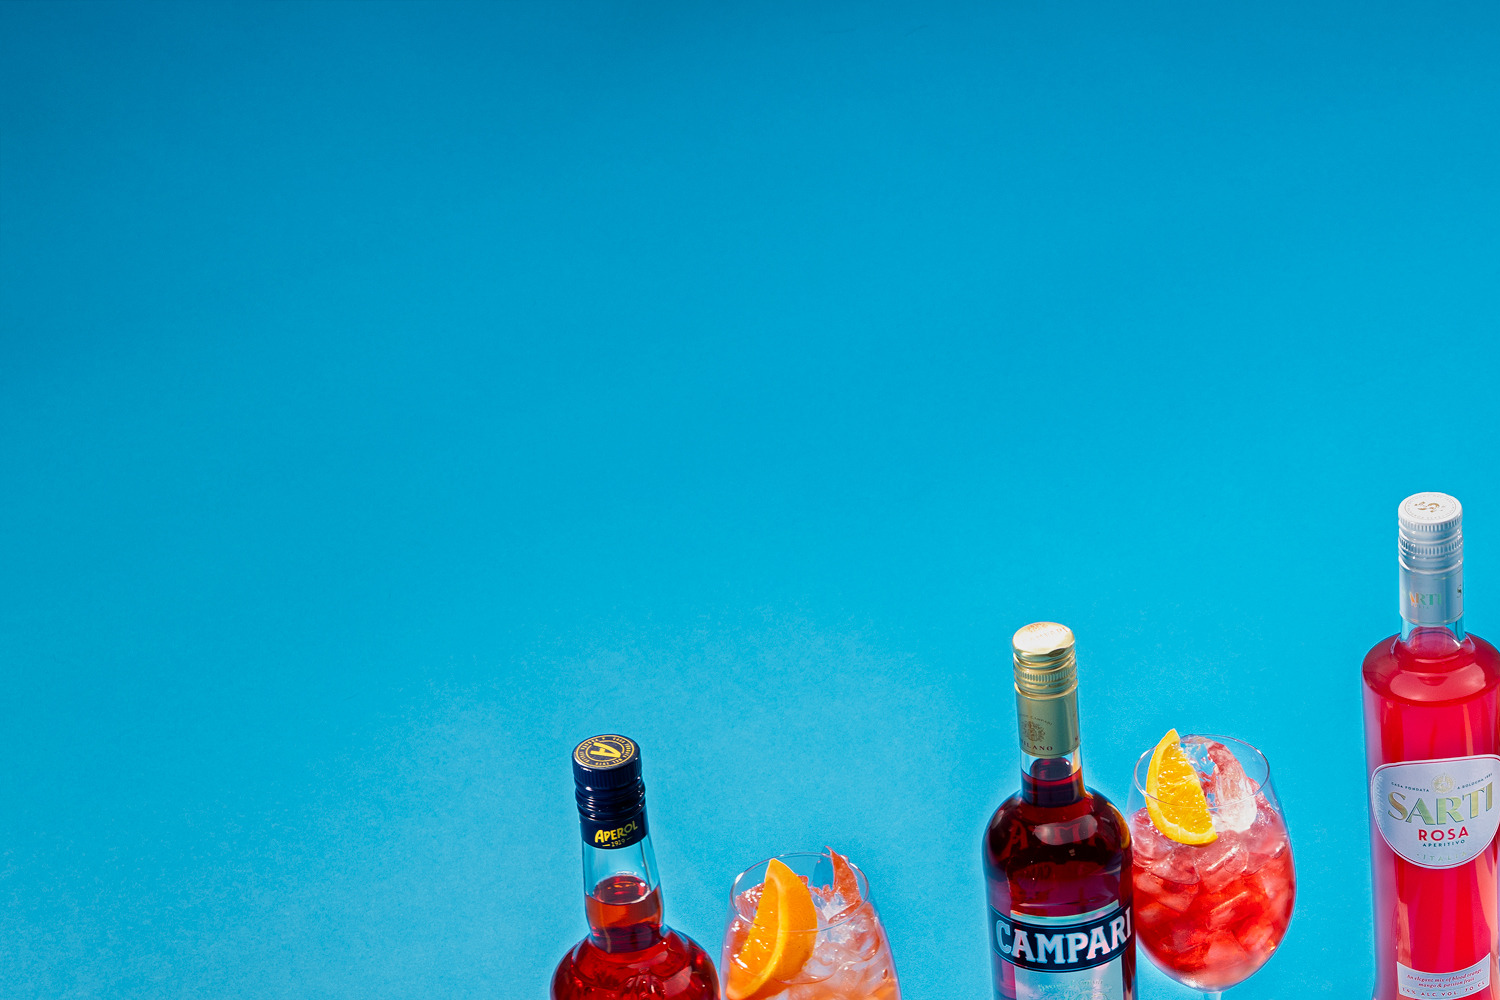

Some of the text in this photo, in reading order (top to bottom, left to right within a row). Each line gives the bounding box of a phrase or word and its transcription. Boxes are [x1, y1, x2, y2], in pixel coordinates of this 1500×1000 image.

[1387, 782, 1493, 826] SARTI
[594, 820, 639, 843] APEROL
[1418, 826, 1469, 842] ROSA
[611, 838, 626, 847] 1919
[1422, 839, 1465, 848] APERITIVO
[1423, 851, 1467, 862] ITALIA
[995, 907, 1132, 964] CAMPARI
[1452, 973, 1467, 981] blood
[1443, 981, 1463, 989] passion
